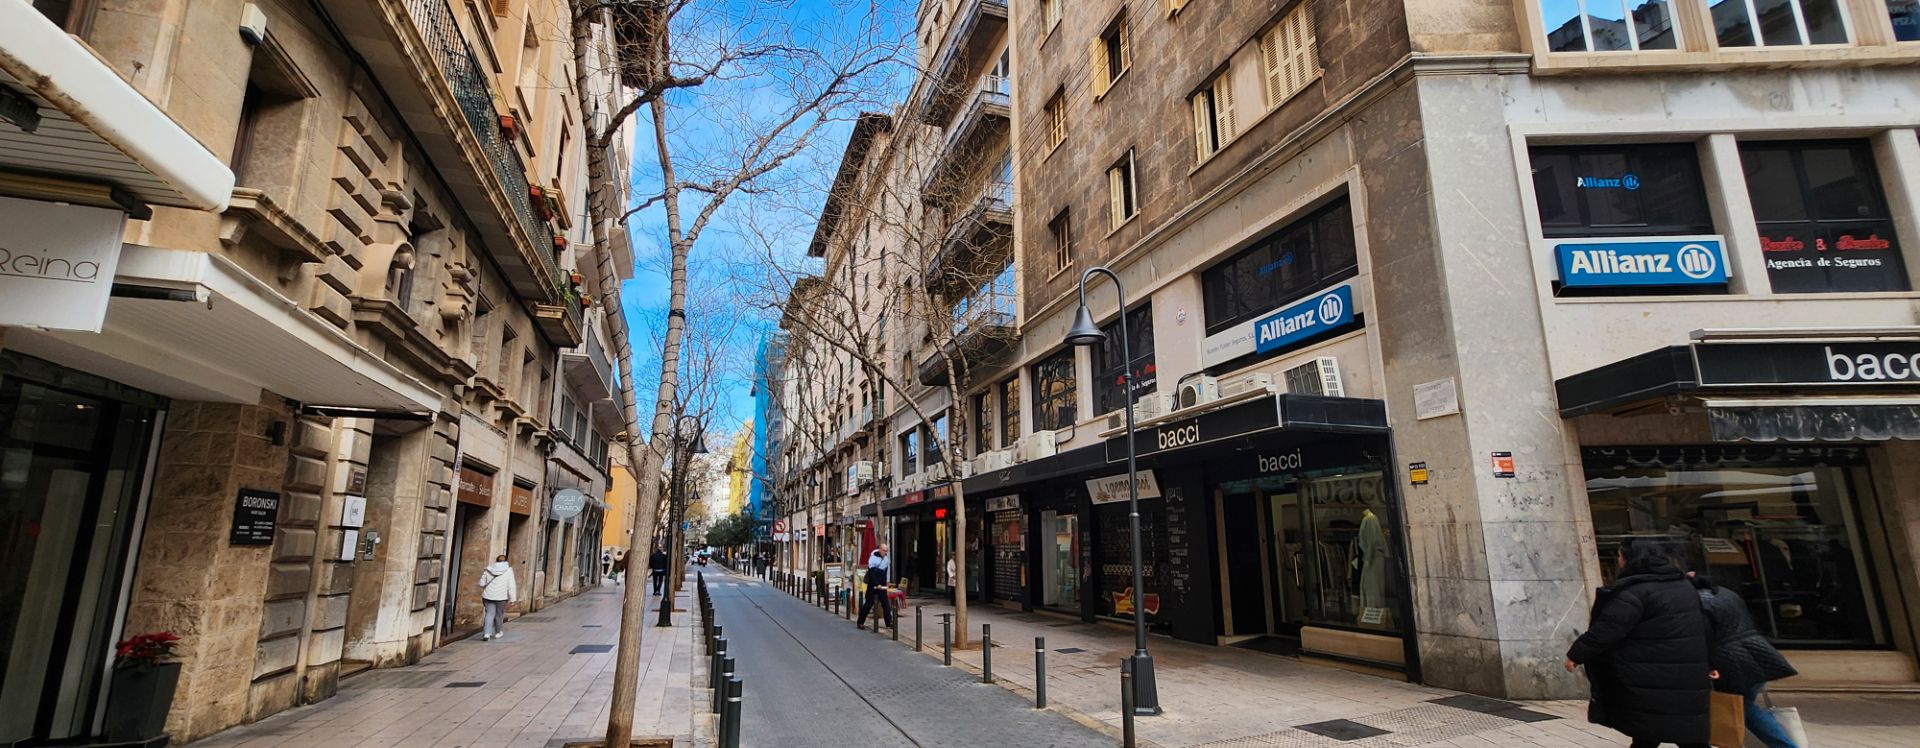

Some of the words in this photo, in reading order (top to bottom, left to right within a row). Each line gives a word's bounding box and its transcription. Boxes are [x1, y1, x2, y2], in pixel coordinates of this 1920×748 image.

[1577, 176, 1621, 188] Allianz
[1571, 249, 1673, 275] Allianz
[1767, 258, 1812, 270] Agencia
[1817, 257, 1831, 267] de
[1833, 257, 1882, 269] Seguros
[1260, 309, 1316, 344] Allianz
[1158, 418, 1200, 449] bacci
[1258, 447, 1303, 473] bacci
[242, 495, 278, 510] BORONSKI
